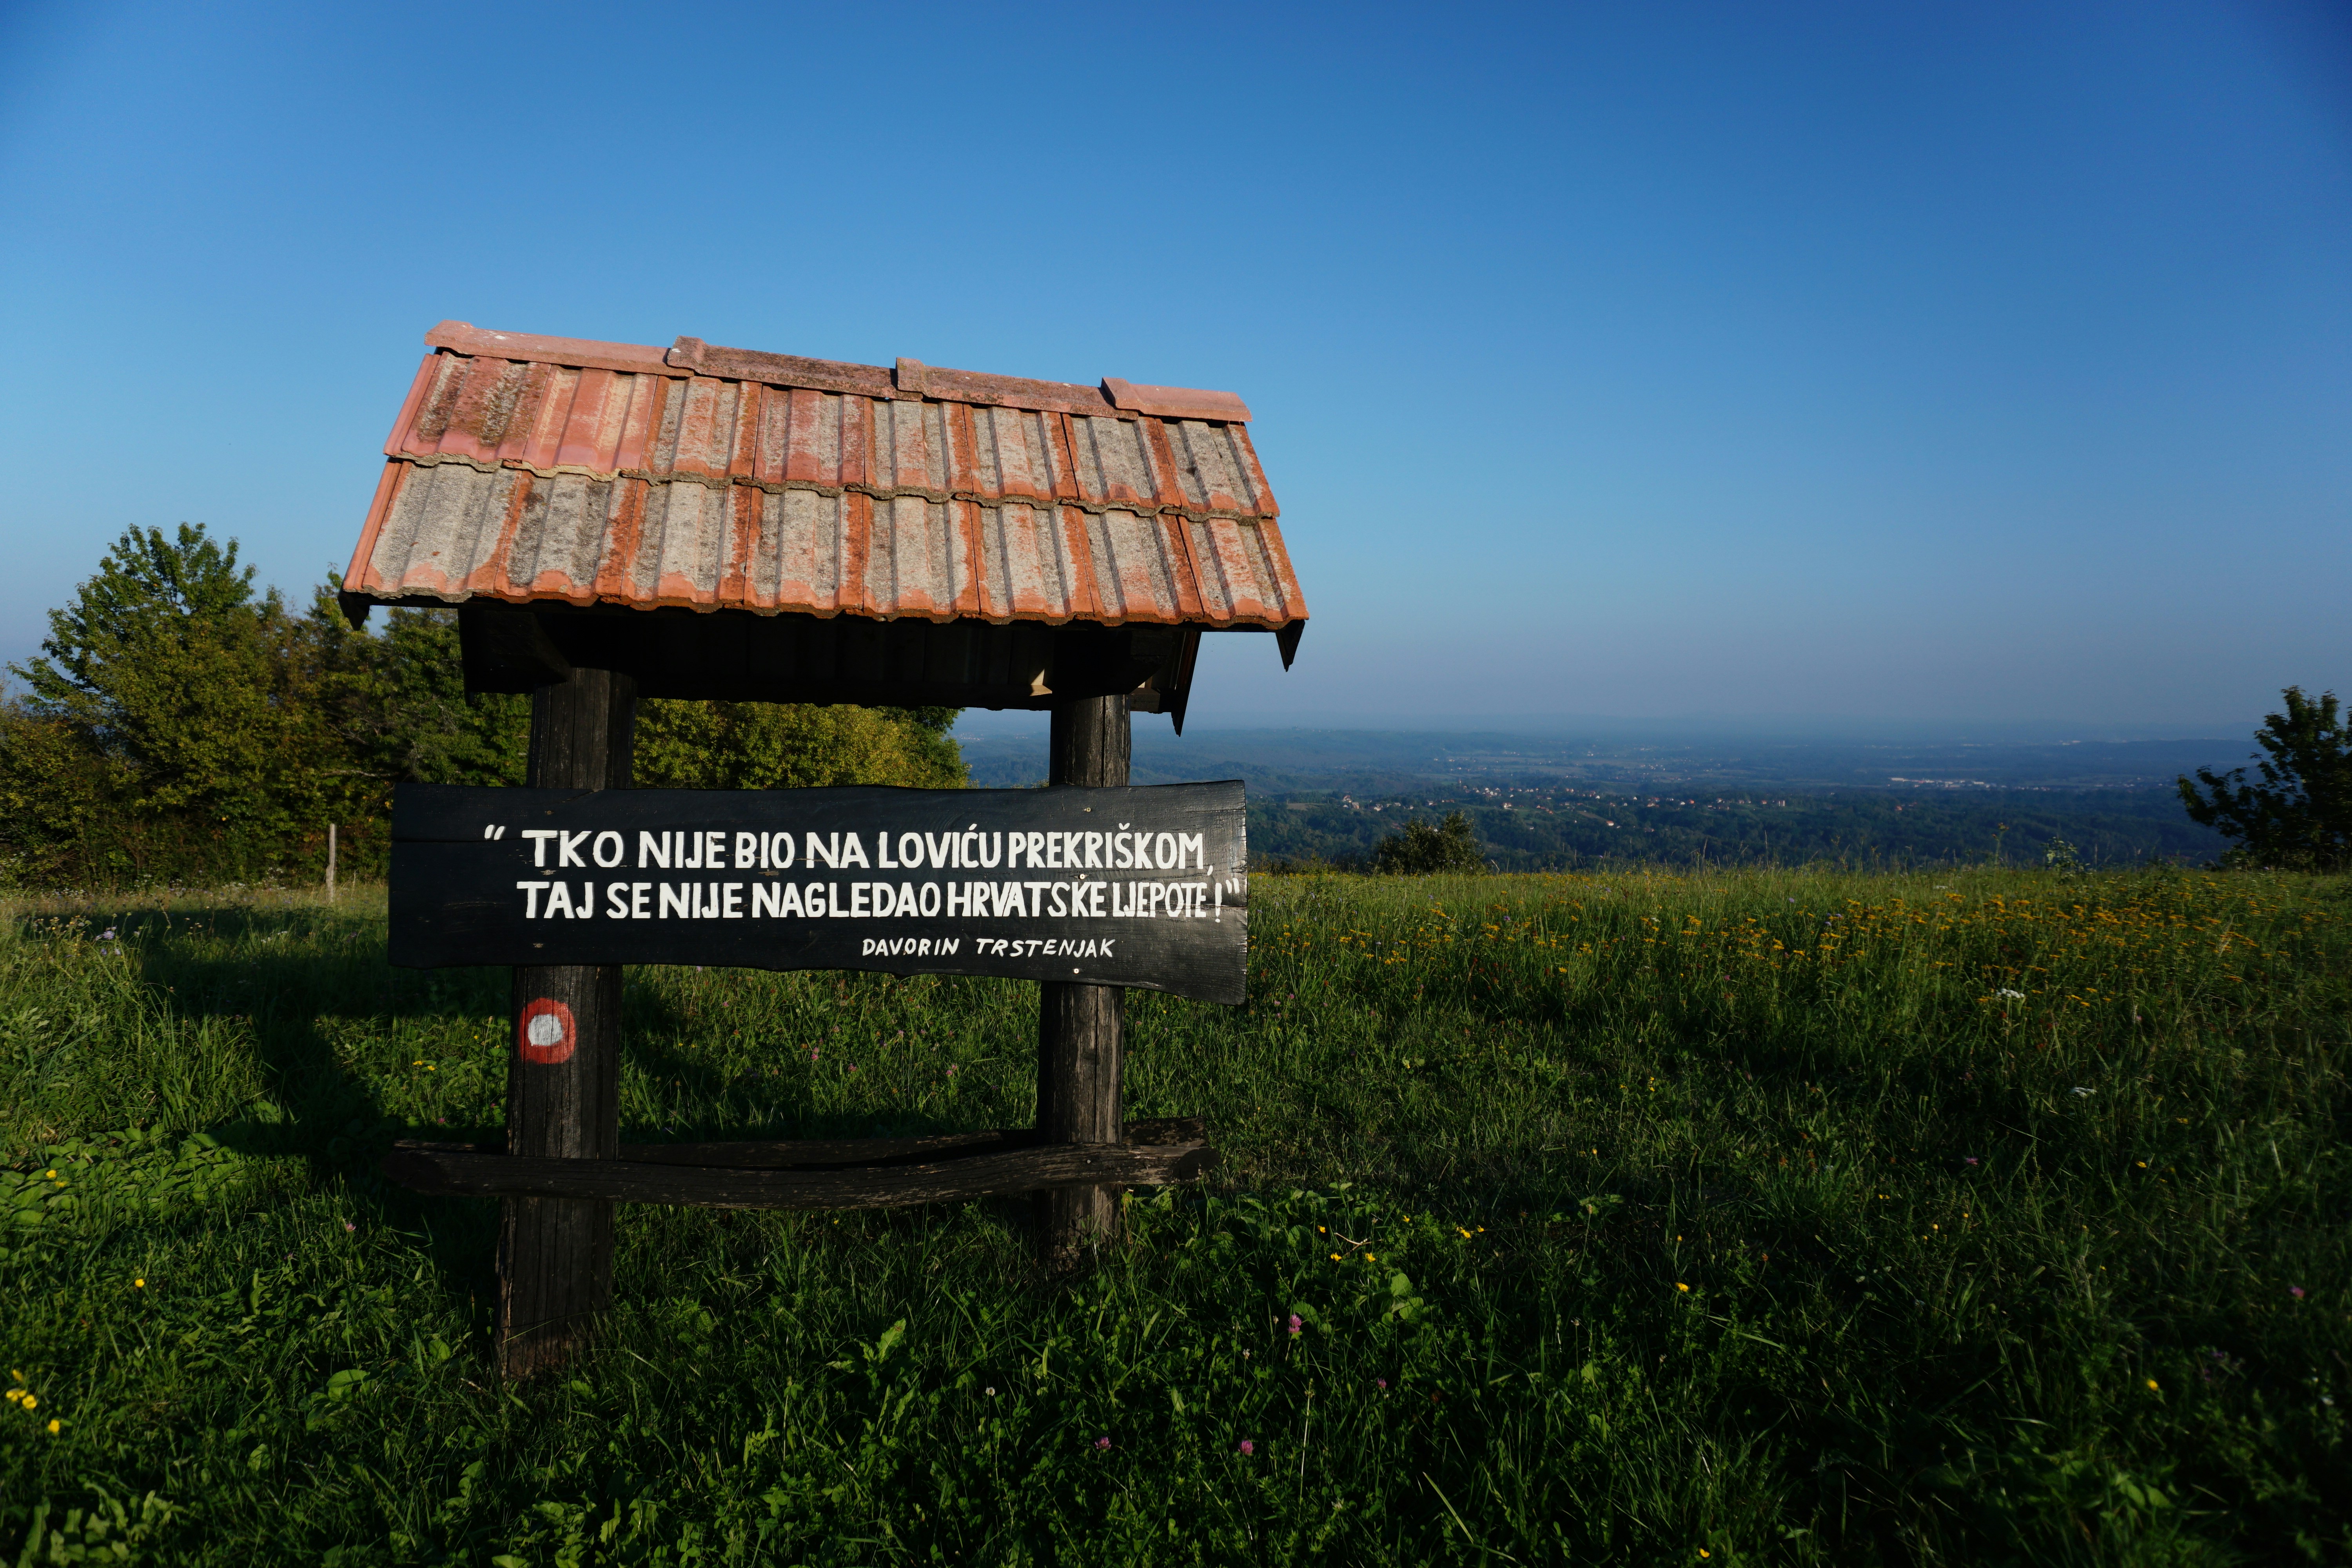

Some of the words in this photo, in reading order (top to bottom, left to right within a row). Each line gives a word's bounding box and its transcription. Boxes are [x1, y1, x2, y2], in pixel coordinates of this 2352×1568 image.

[638, 831, 726, 869] NIJE
[735, 831, 795, 869] BIO
[806, 832, 871, 869] NA
[878, 823, 1002, 868] LOVIĆU
[1008, 822, 1213, 876] PREKRIŠKOM,
[516, 881, 594, 919] TAJ
[606, 882, 652, 919] SE
[659, 882, 743, 919] NIJE
[752, 882, 941, 918] NAGLEDAO
[947, 880, 1107, 917] HRVATSKE
[862, 937, 960, 956] DAVORIN
[976, 938, 1116, 958] TRSTENJAK
